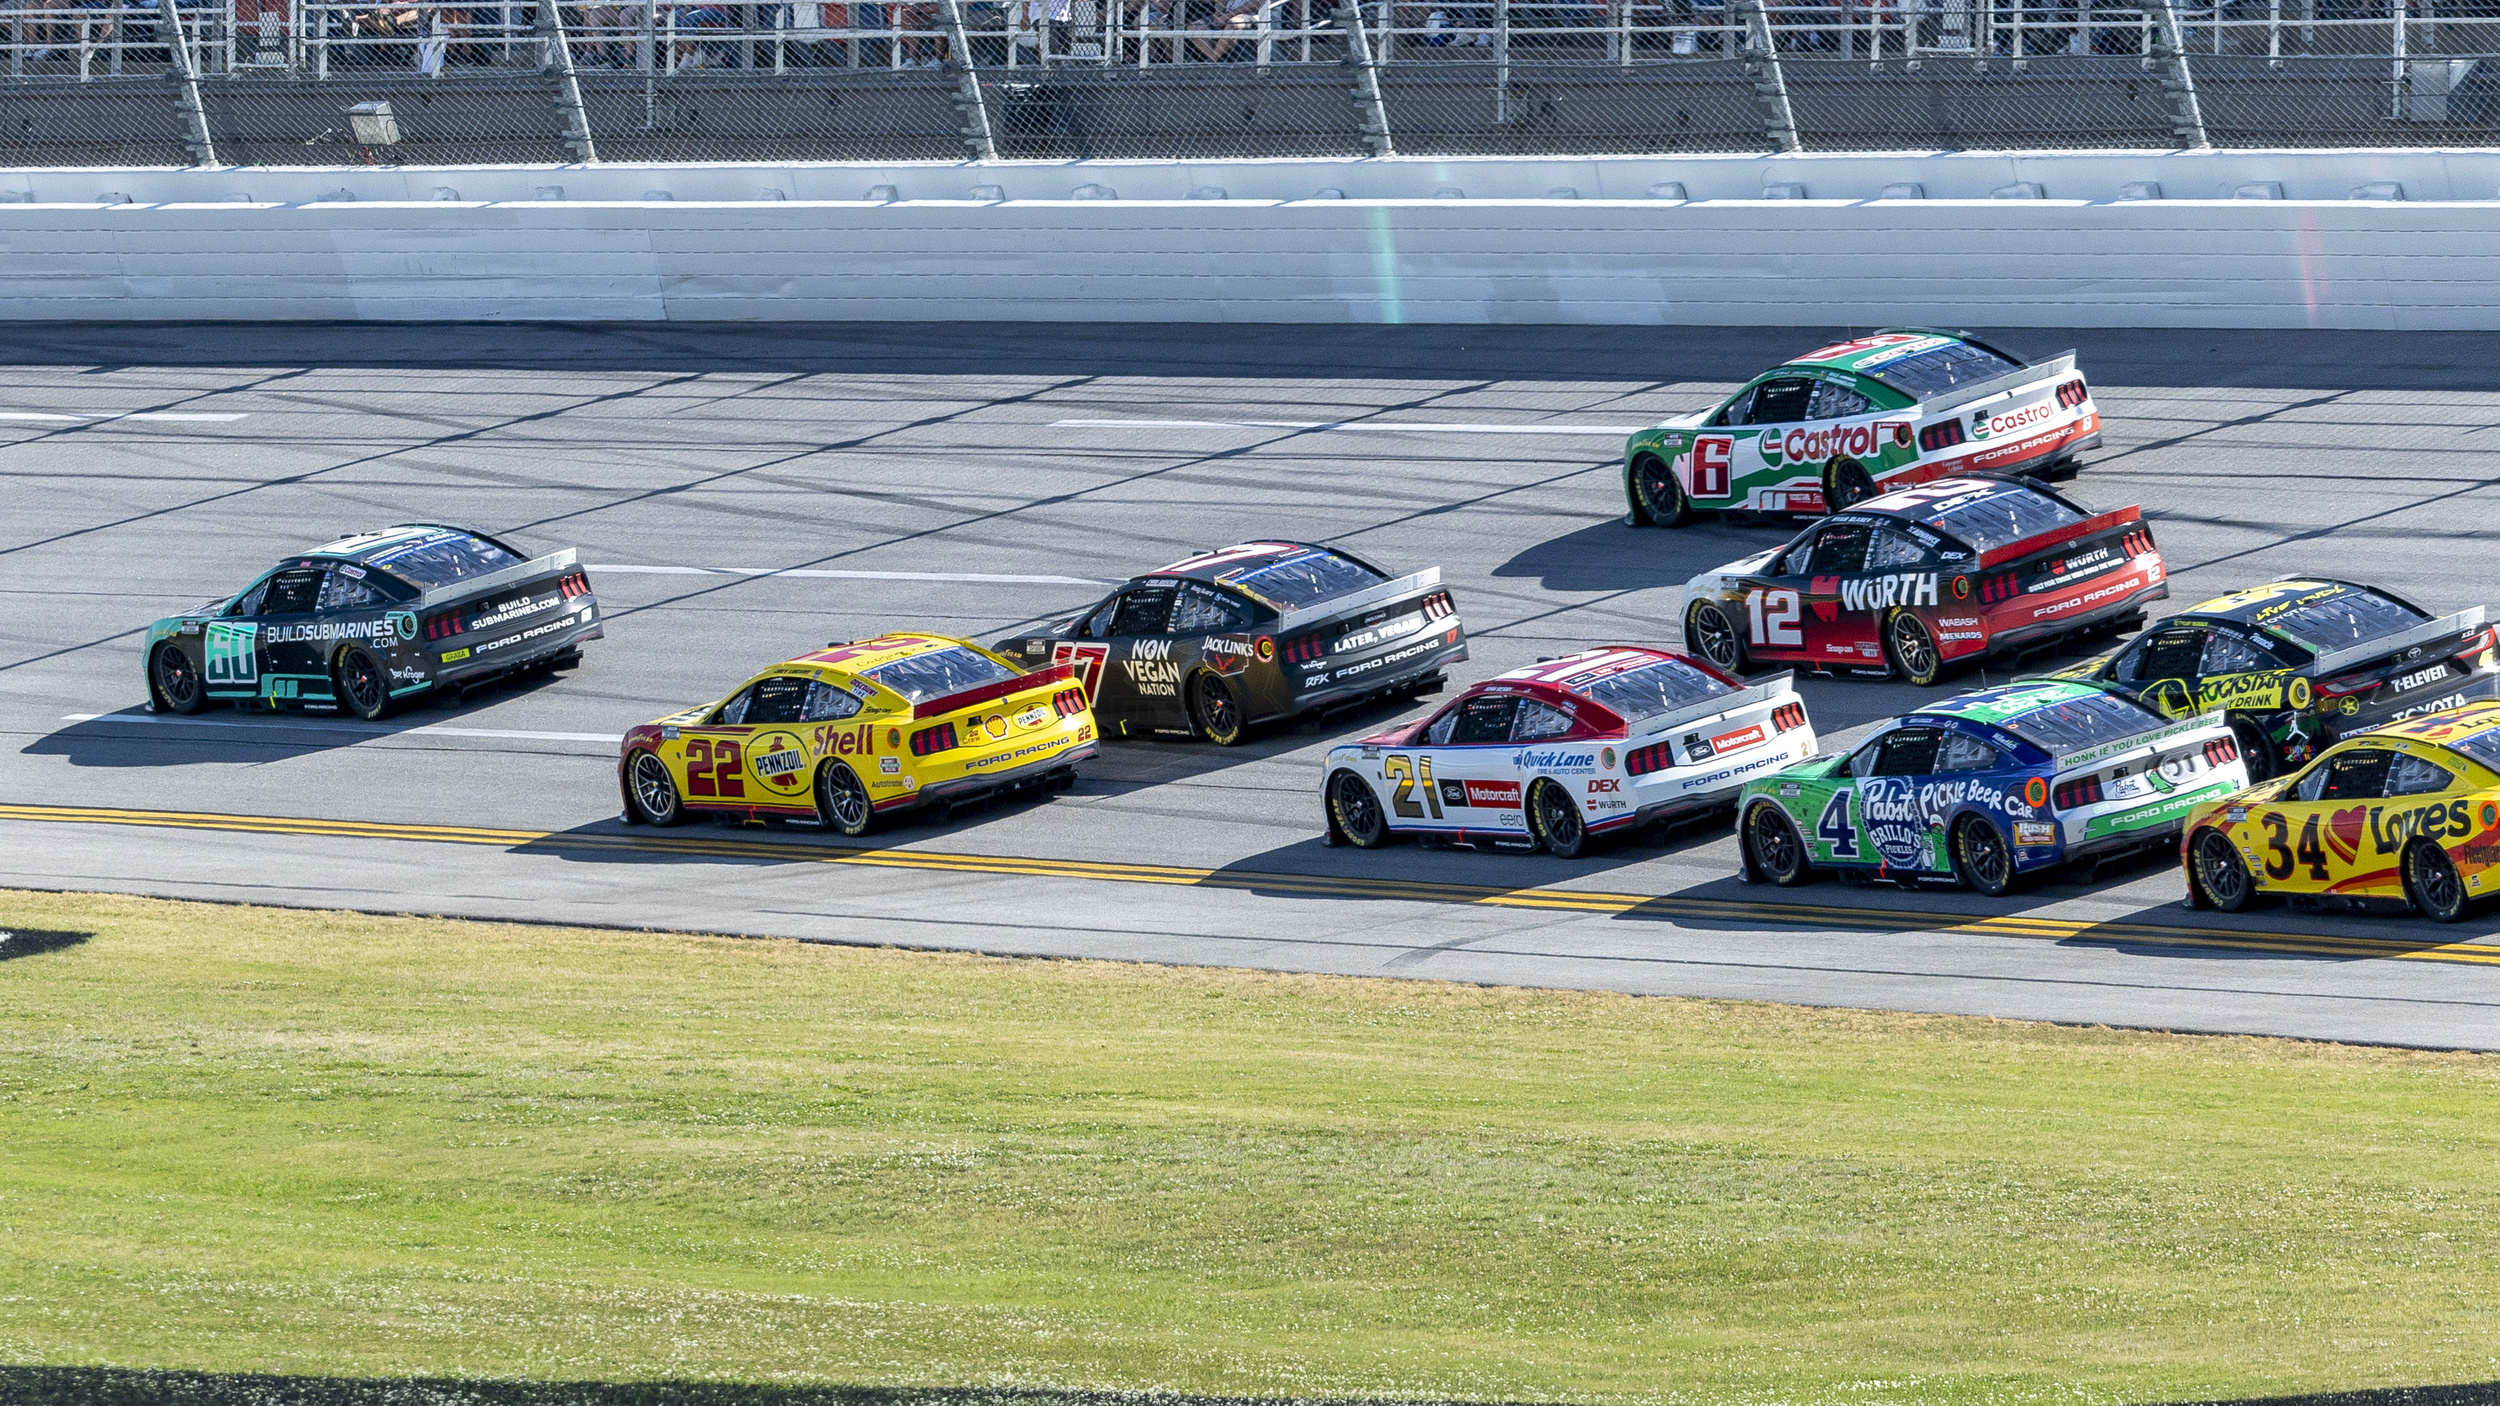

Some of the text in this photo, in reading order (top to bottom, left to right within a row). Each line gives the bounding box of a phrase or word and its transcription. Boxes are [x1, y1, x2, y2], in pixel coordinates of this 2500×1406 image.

[1991, 401, 2054, 433] Castrol
[1785, 422, 1878, 461] Castrol
[1973, 425, 2075, 464] FORD RACING
[1691, 435, 1734, 498] 6
[1941, 551, 1968, 559] DEX
[2147, 565, 2161, 583] 12
[498, 596, 531, 612] BUILD
[2033, 577, 2140, 618] FORD RACING
[471, 597, 560, 630] SUBMARINES.COM
[1744, 588, 1804, 648] 12
[1939, 617, 1978, 627] WABASH
[267, 620, 394, 643] BUILDSUBMARINES
[475, 615, 576, 654] FORD RACING
[1334, 631, 1379, 653] LATER,
[1378, 617, 1423, 639] VEGAN
[1446, 628, 1458, 644] 17
[1939, 631, 1983, 641] MENARDS
[205, 622, 258, 683] 60
[369, 637, 399, 649] .COM
[1132, 639, 1172, 660] NON
[1202, 635, 1225, 654] JACK
[1336, 638, 1440, 679] FORD RACING
[403, 666, 425, 684] Kroger
[1123, 660, 1181, 683] VEGAN
[1305, 673, 1330, 688] RFK
[850, 678, 879, 697] DISCOUNT
[1138, 683, 1176, 696] NATION
[2235, 693, 2273, 708] DRINK
[1018, 708, 1047, 725] PENNZOIL
[813, 724, 874, 756] Shell
[962, 736, 981, 745] Crew
[1077, 725, 1092, 743] 22
[1716, 729, 1762, 749] Motorcraft
[2064, 715, 2220, 766] HONK IF YOU LOVE PICKLE BEER
[755, 749, 804, 777] PENNZOIL
[965, 736, 1070, 770] FORD RACING
[685, 738, 746, 798] 22
[1682, 752, 1789, 790] FORD RACING
[871, 780, 903, 788] Autotrader
[1385, 754, 1444, 820] 21
[1587, 779, 1621, 793] DEX
[2113, 779, 2136, 793] Pabst
[2233, 779, 2241, 791] 4
[1470, 787, 1521, 802] Motorcraft
[1598, 800, 1627, 809] WÜRTH
[1865, 779, 1914, 821] Pabst
[2110, 806, 2161, 827] FORD
[2163, 788, 2222, 813] RACING
[1500, 814, 1524, 826] eero
[1817, 786, 1860, 859] 4
[2018, 823, 2051, 836] RUSH
[1869, 823, 1922, 849] GRILLO'S
[2261, 811, 2331, 881] 34
[1885, 844, 1913, 854] PICKLES
